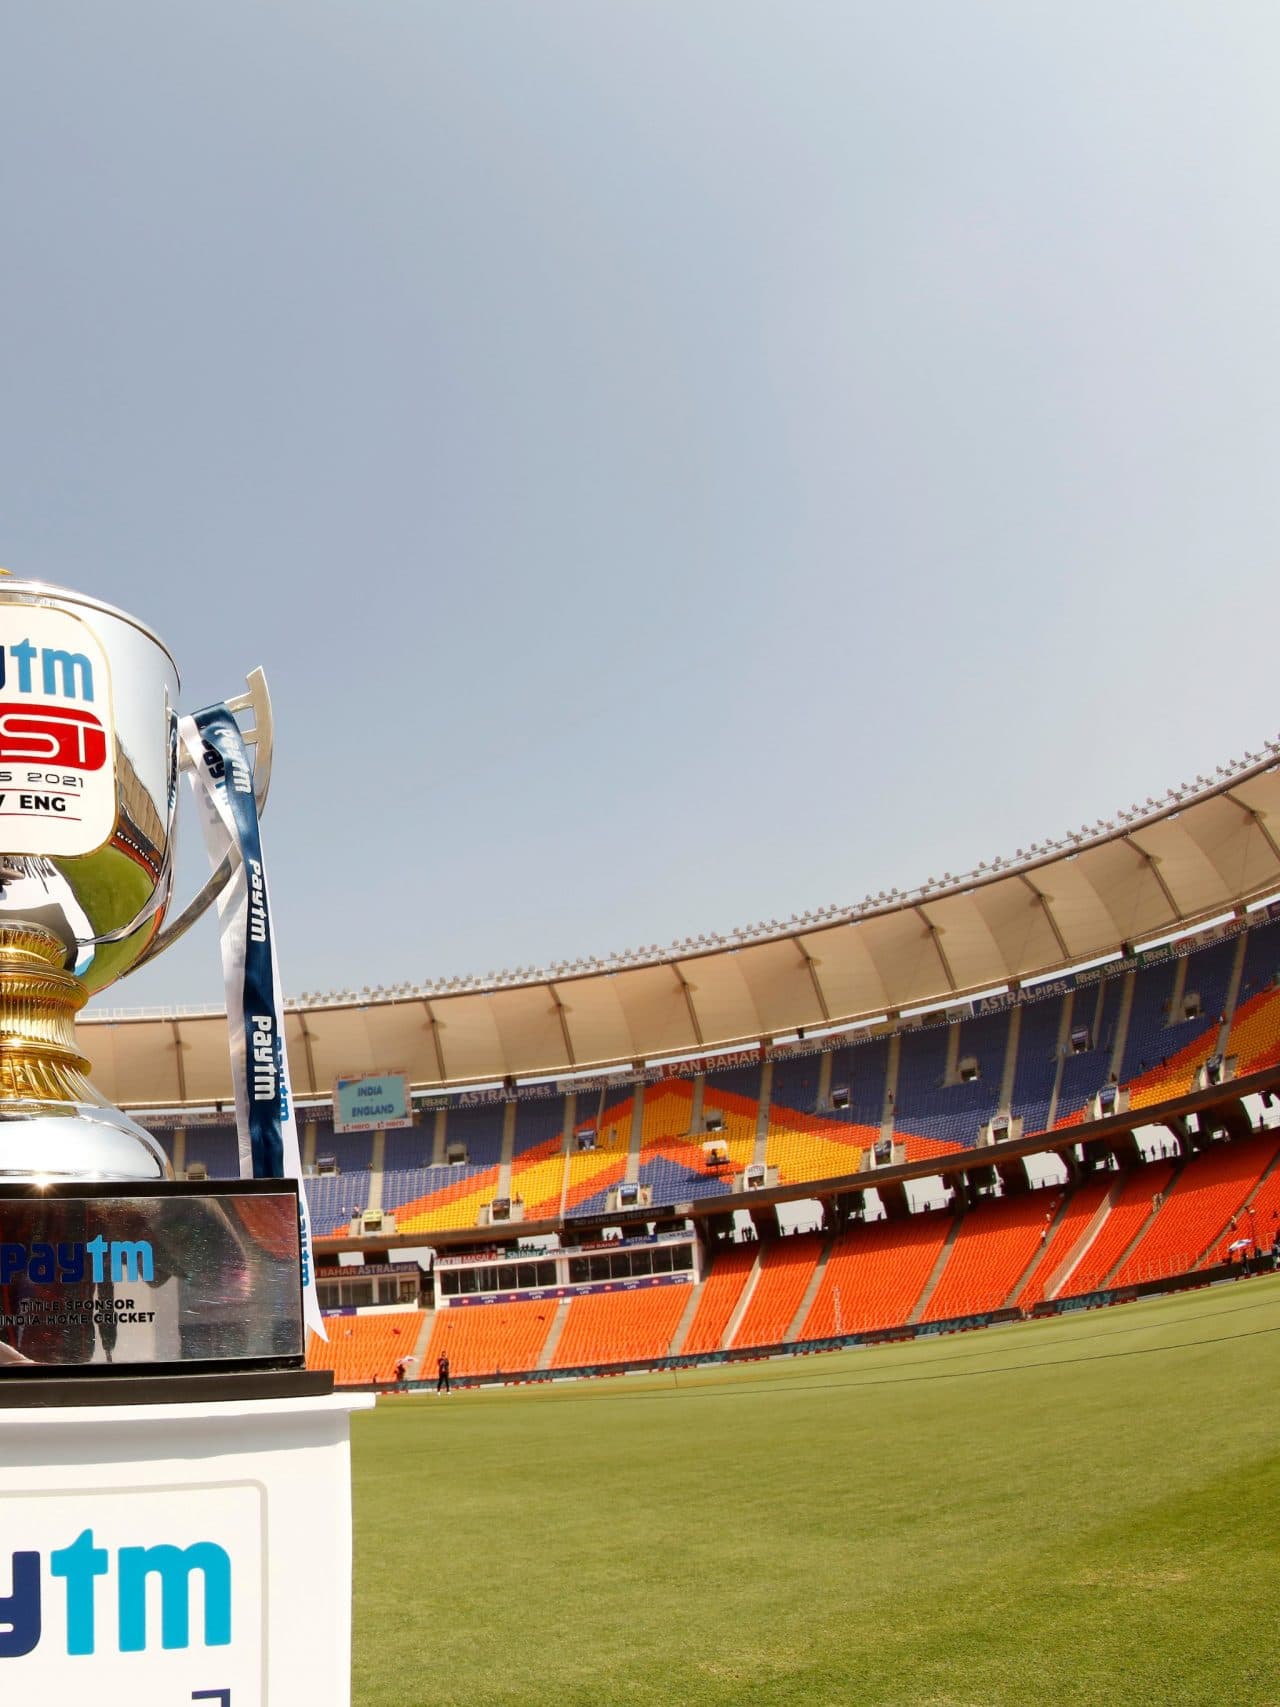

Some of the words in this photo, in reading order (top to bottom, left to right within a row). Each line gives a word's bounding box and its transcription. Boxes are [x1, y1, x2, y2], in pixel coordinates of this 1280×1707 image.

[27, 771, 84, 788] 2021
[20, 795, 66, 812] ENG
[248, 858, 267, 942] paytm
[980, 987, 1035, 1012] ASTRAL
[1035, 980, 1068, 996] PIPES
[252, 1015, 278, 1101] paytm
[669, 1060, 701, 1075] PAN
[706, 1050, 761, 1069] BAHAR
[357, 1085, 383, 1097] INDIA
[459, 1088, 517, 1104] ASTRAL
[518, 1086, 551, 1098] PIPES
[351, 1104, 395, 1118] ENGLAND
[0, 1234, 155, 1284] paytm
[320, 1267, 357, 1278] BAHAR
[357, 1264, 396, 1275] ASTRAL
[20, 1300, 61, 1312] TITLE
[66, 1299, 136, 1311] SPONSOR
[0, 1315, 41, 1327] INDIA
[47, 1314, 89, 1325] HOME
[93, 1312, 156, 1325] CRICKET
